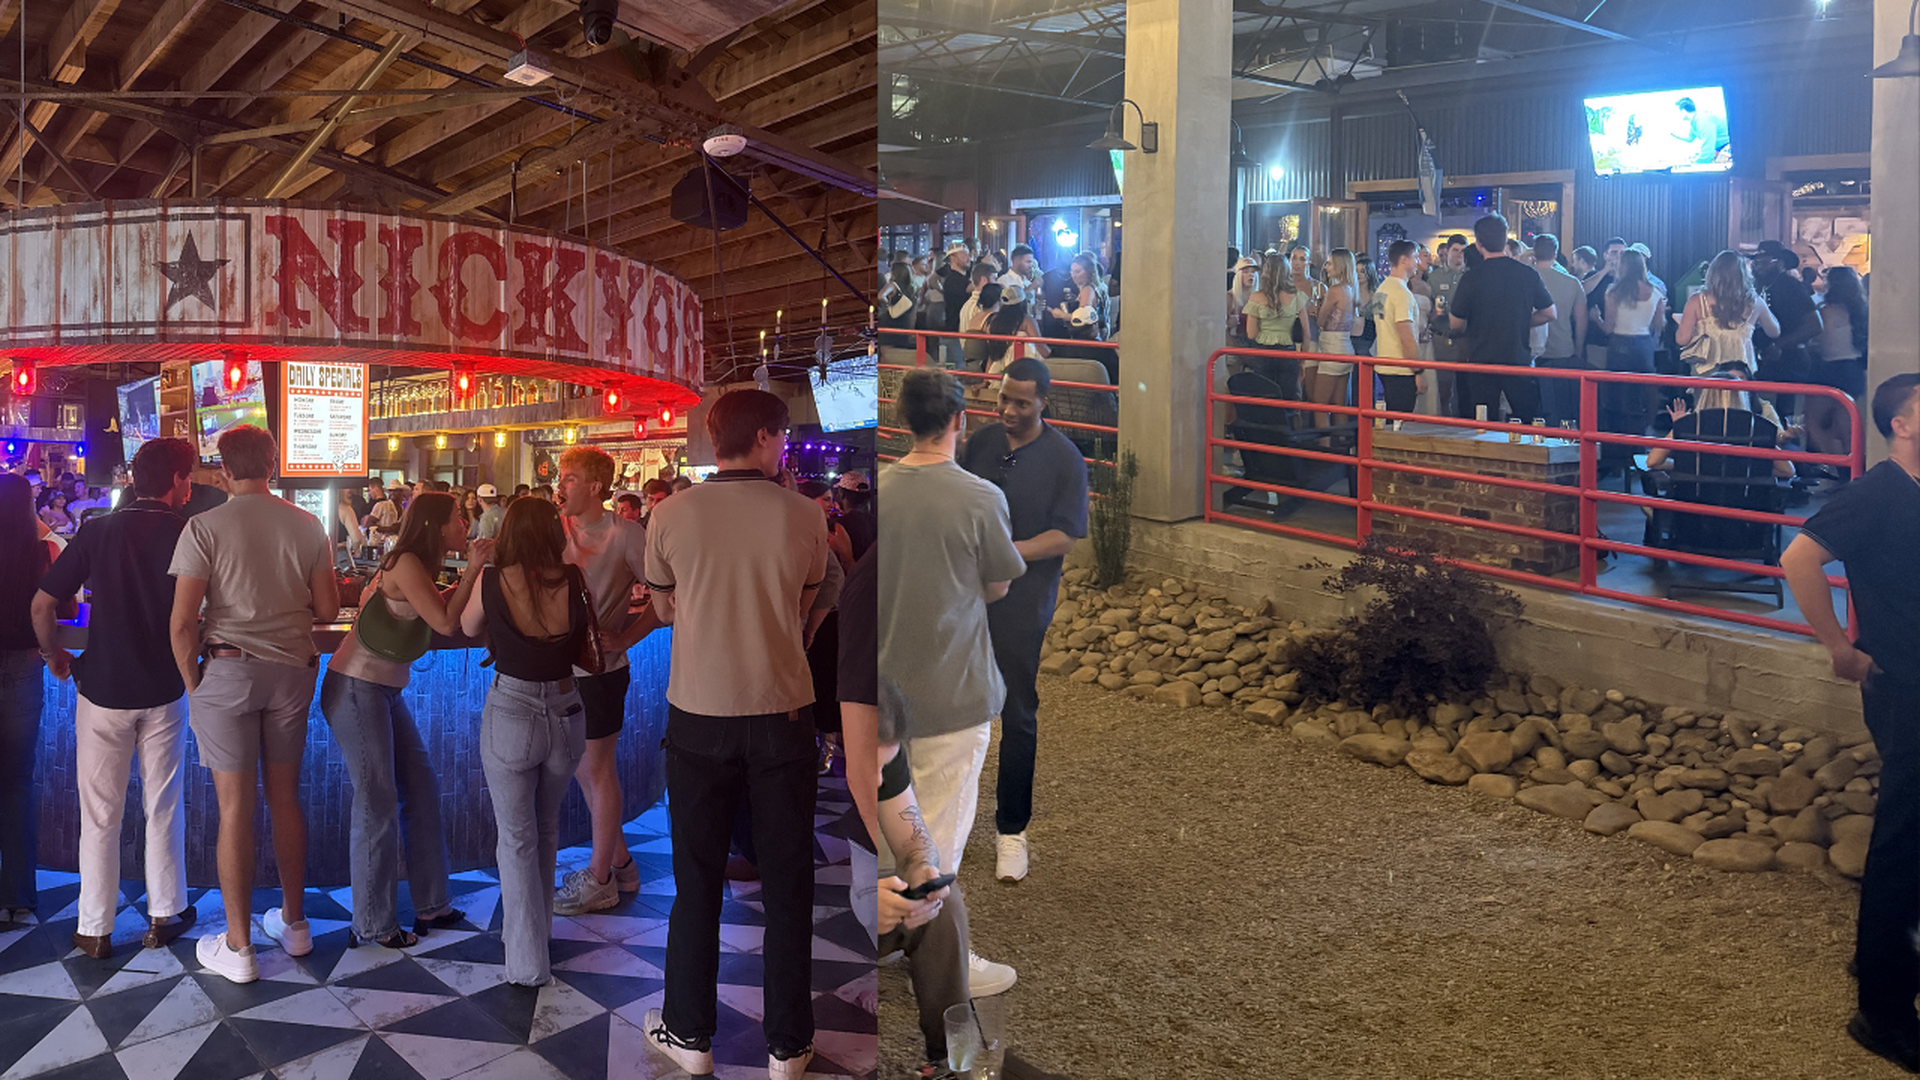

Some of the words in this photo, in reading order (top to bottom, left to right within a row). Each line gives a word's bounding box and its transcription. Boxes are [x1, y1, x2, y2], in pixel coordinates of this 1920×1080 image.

[264, 216, 700, 380] NICKYO'S
[289, 364, 315, 386] DAILY
[319, 365, 362, 389] SPECIALS
